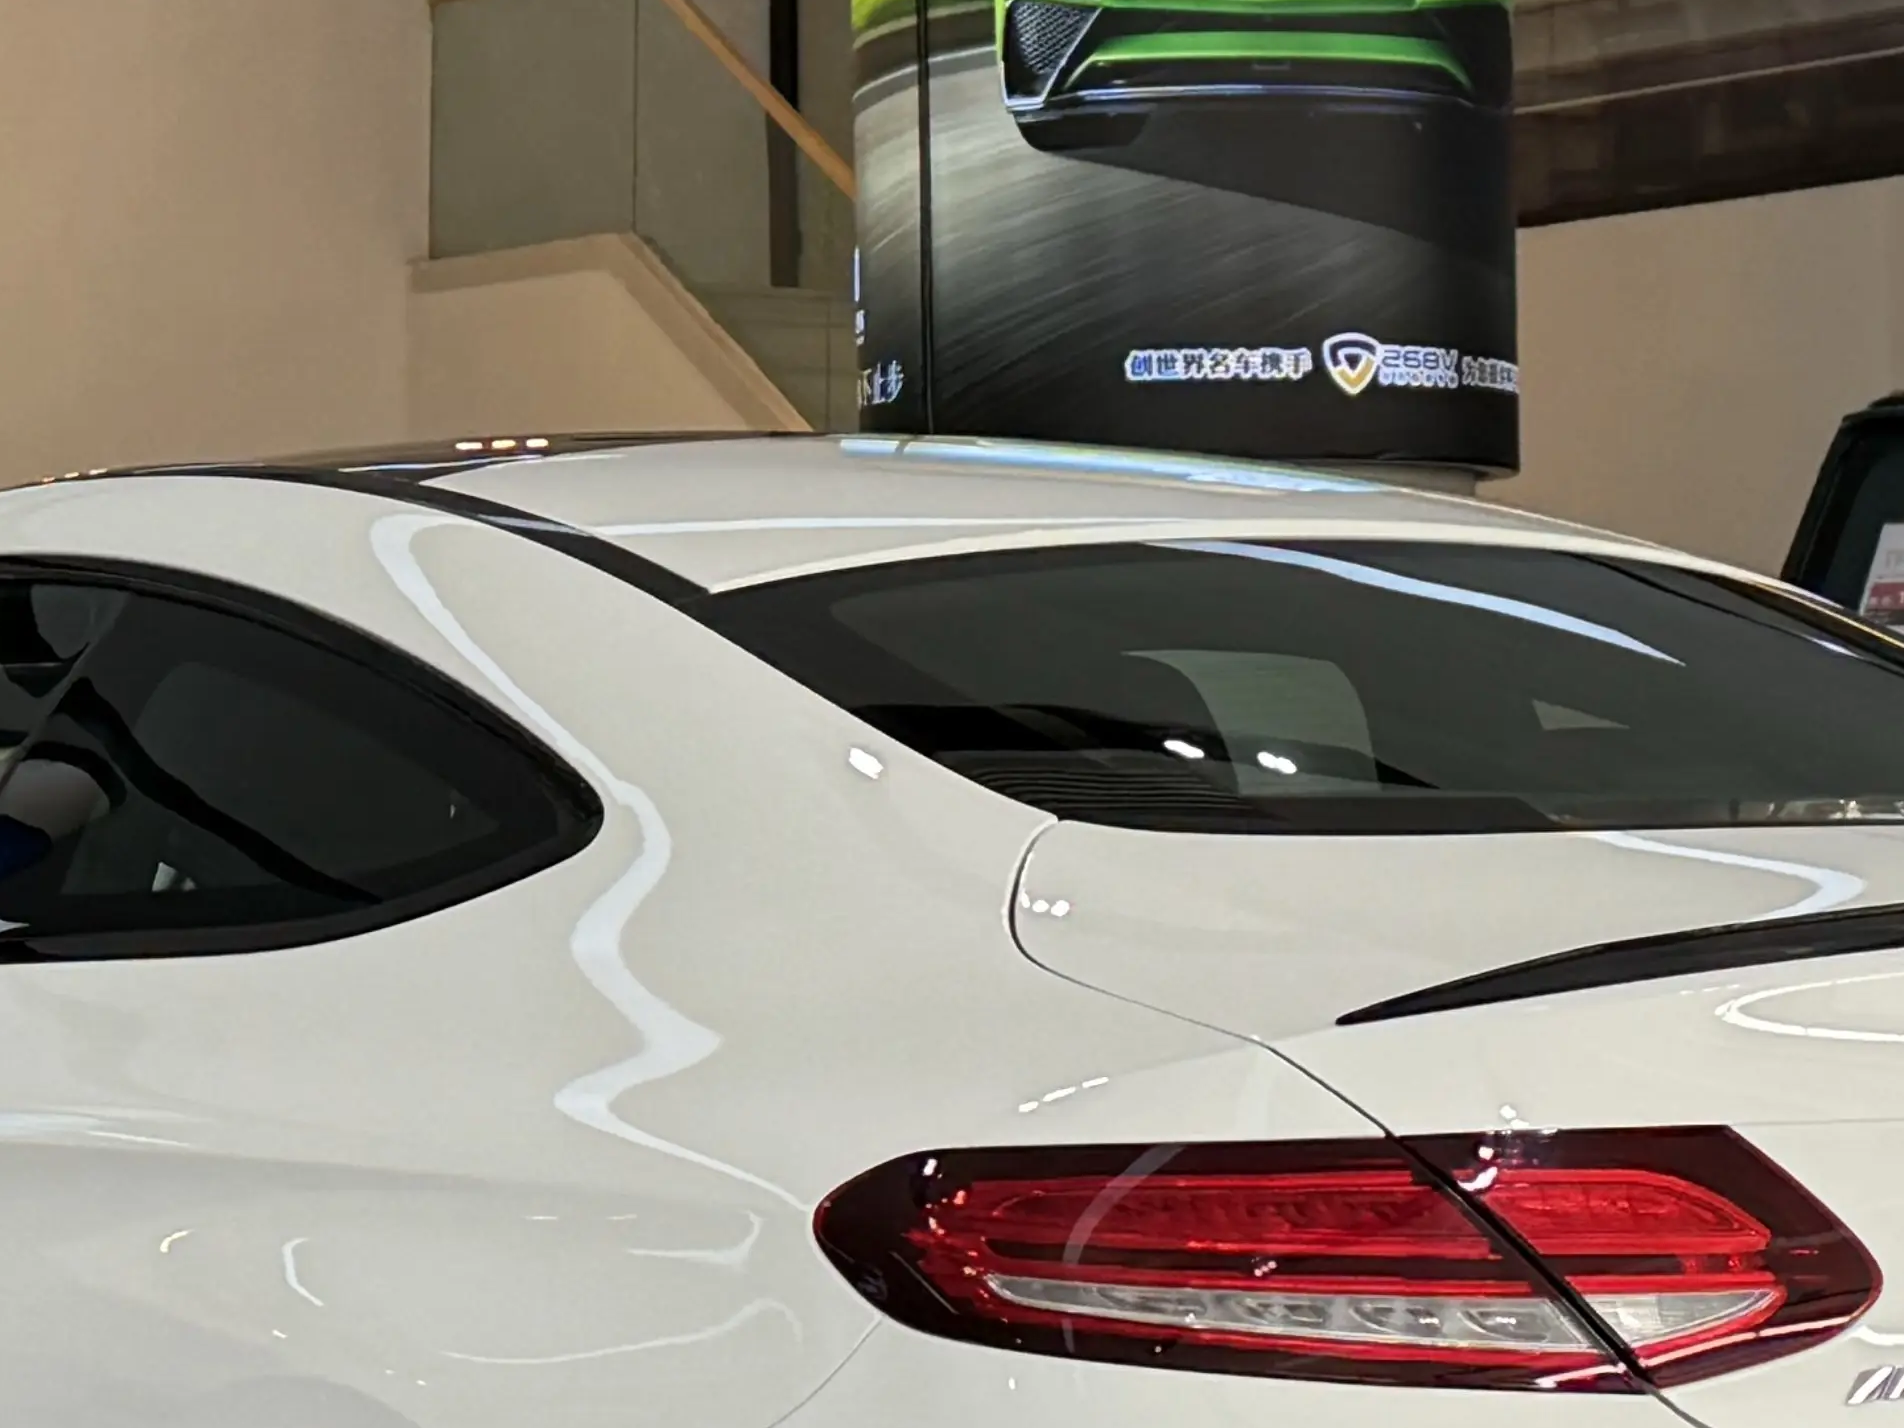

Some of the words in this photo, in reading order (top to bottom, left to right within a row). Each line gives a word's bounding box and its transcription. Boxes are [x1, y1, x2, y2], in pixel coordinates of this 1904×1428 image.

[1126, 346, 1313, 380] 创世界名车携手
